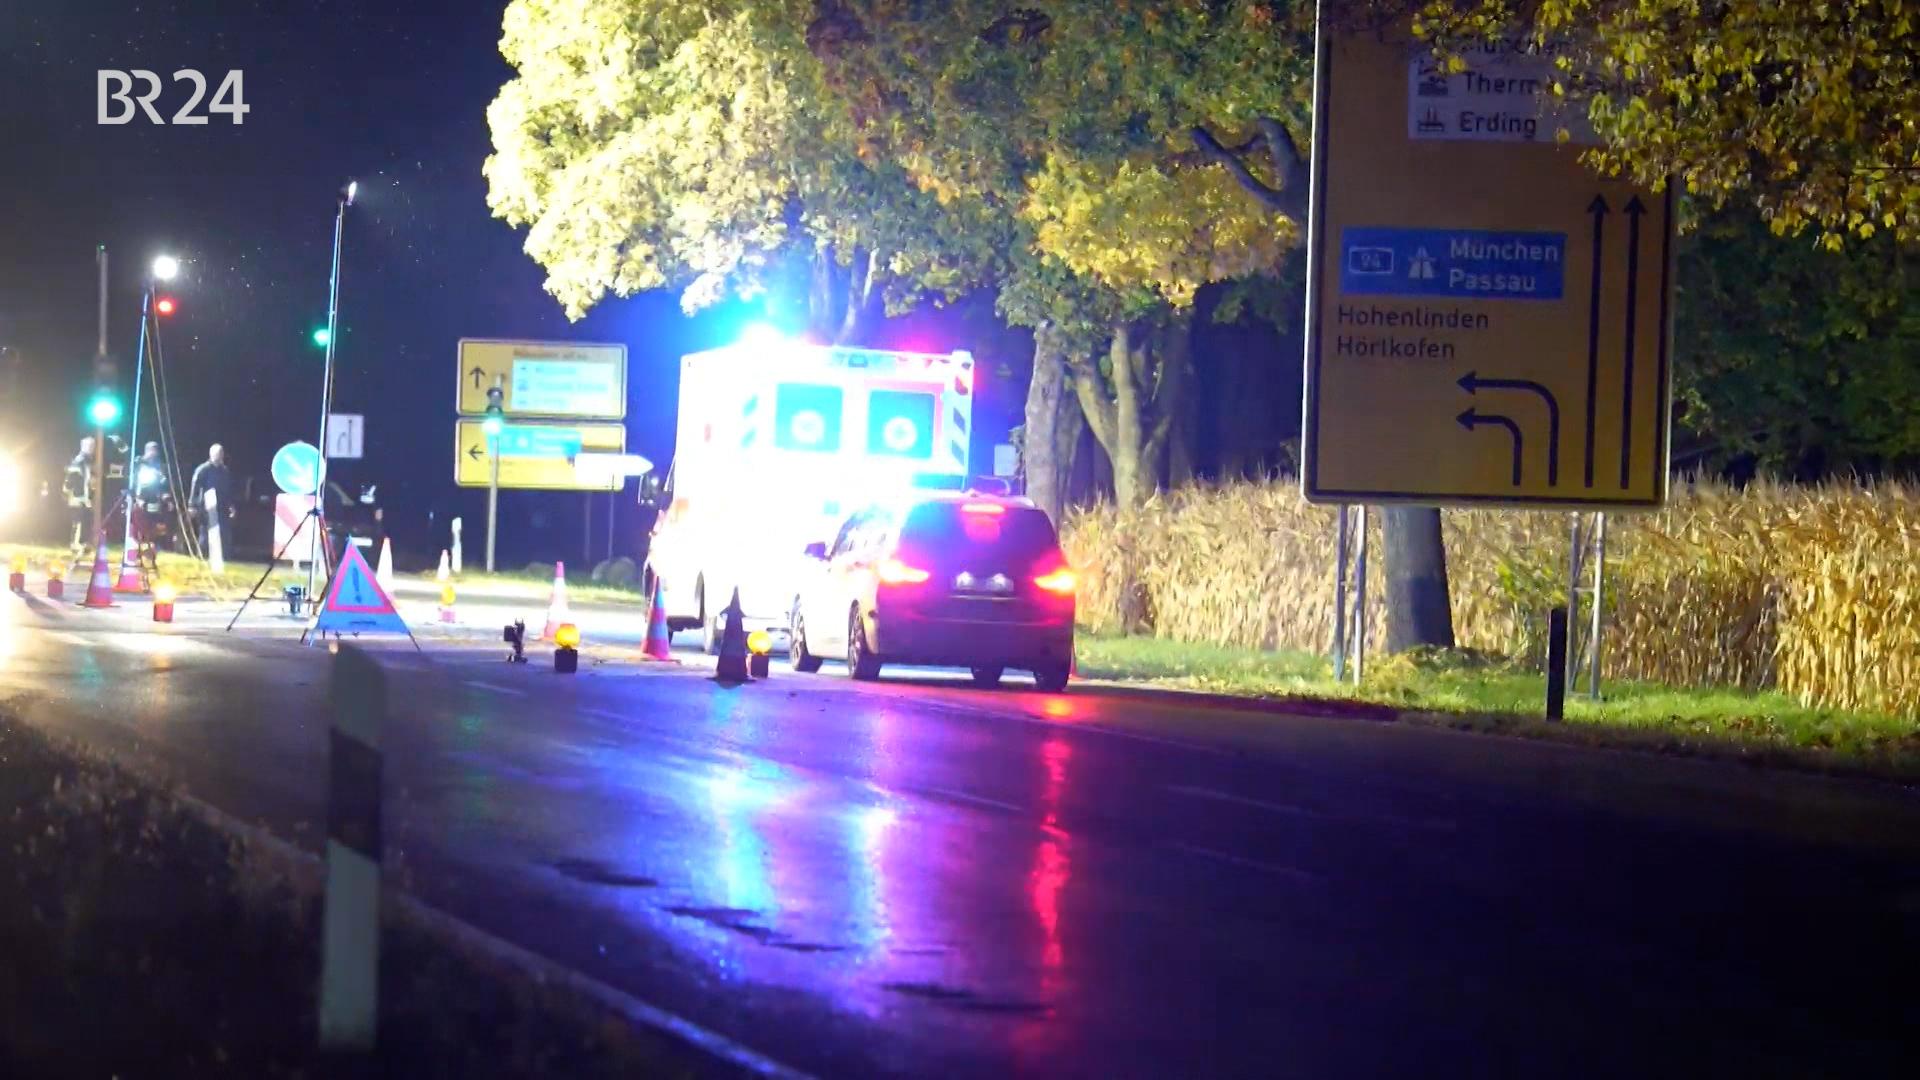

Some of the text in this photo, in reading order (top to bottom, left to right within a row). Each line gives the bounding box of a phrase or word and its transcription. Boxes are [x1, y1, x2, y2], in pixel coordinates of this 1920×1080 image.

[1464, 71, 1545, 95] Therm
[1460, 110, 1537, 139] Erding
[1448, 237, 1560, 263] München
[1448, 267, 1538, 293] Passau
[1337, 304, 1489, 329] Hohenlinden
[1336, 335, 1455, 358] Hörlkofen
